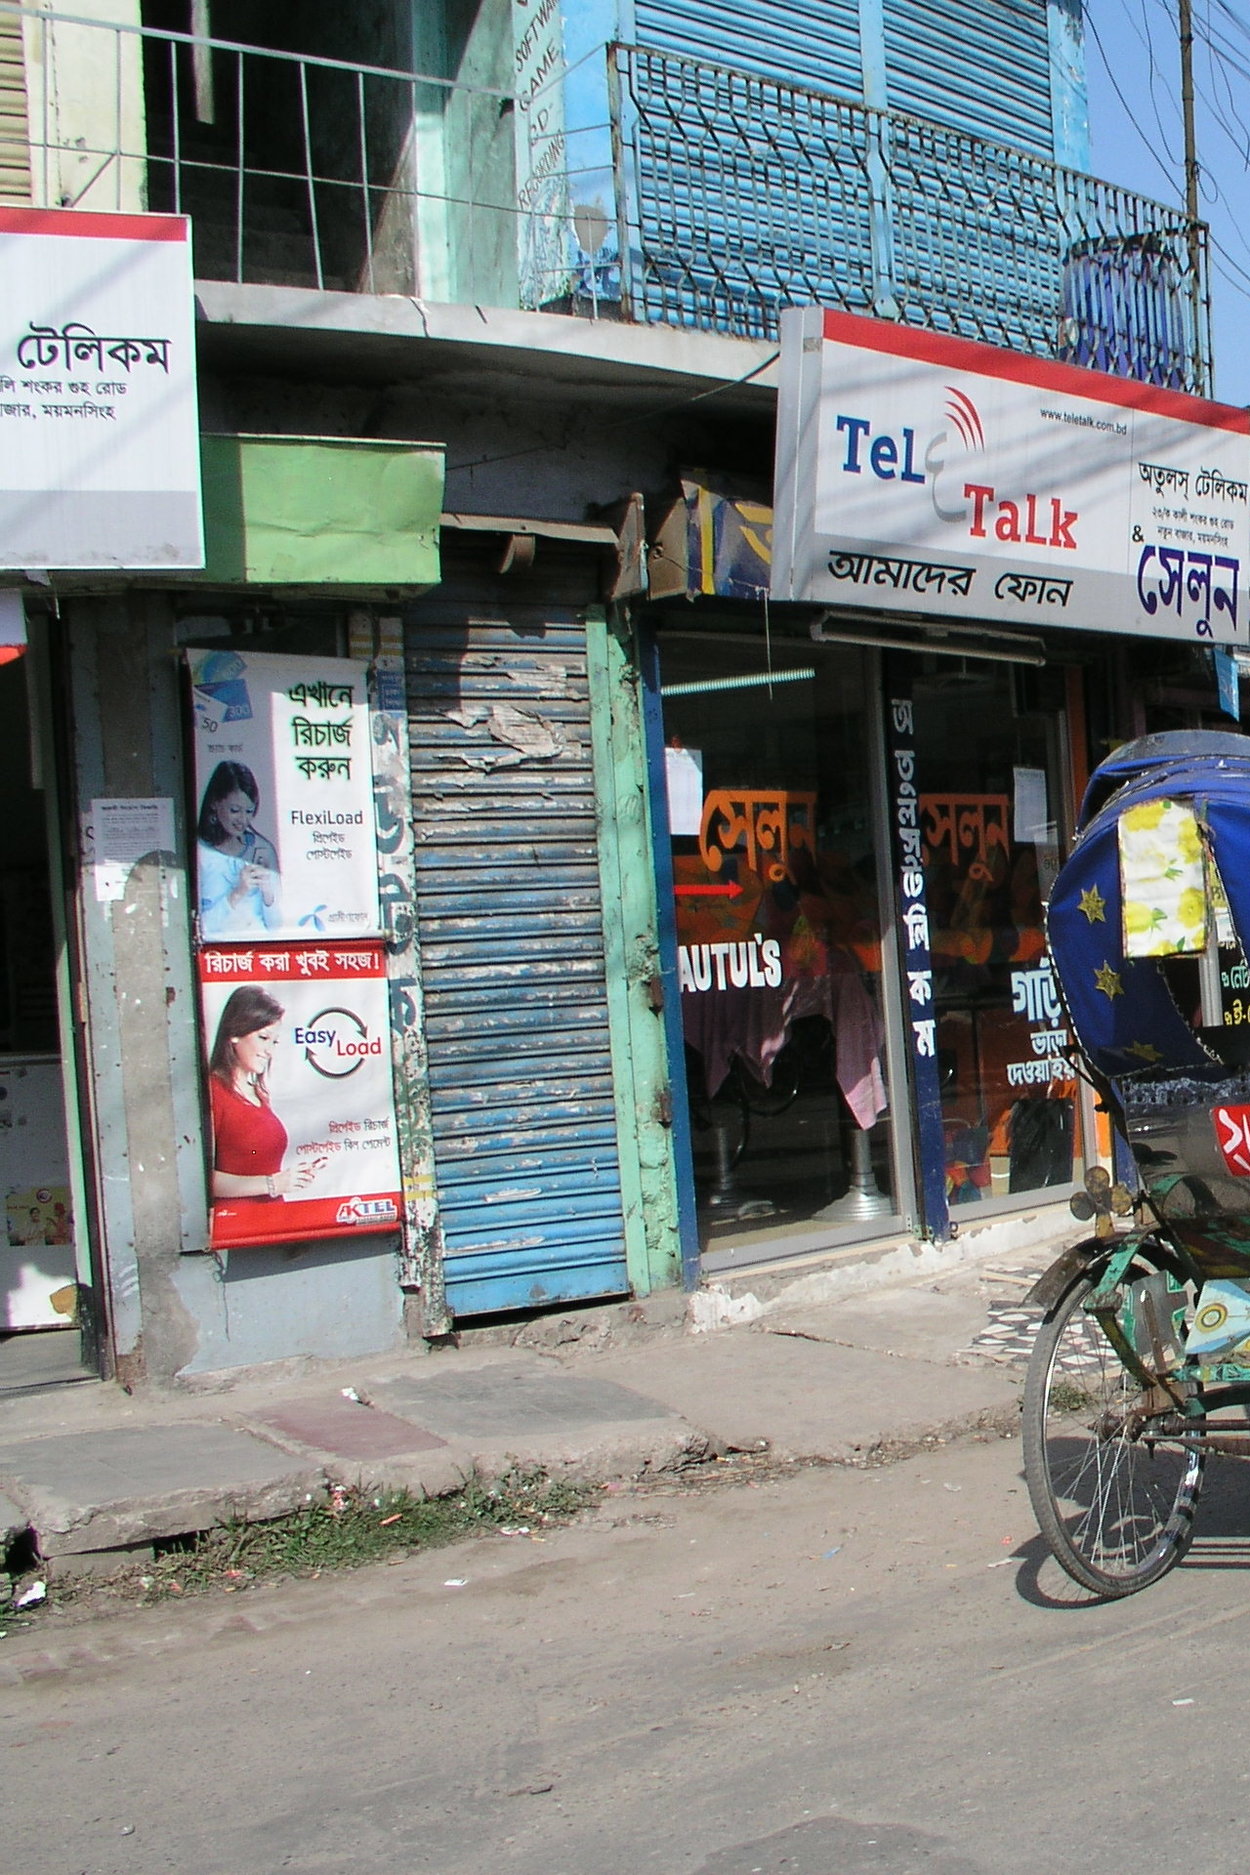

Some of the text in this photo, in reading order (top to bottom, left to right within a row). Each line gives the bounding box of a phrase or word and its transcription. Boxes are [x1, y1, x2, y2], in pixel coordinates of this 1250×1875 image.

[17, 321, 172, 374] টেলিকম
[42, 400, 118, 420] ময়মনসিংহ
[1040, 408, 1127, 435] www.teletalk.com.bd
[1195, 466, 1249, 506] টেলিকম
[1132, 525, 1144, 543] &
[827, 550, 1074, 608] আমাদের ফোন
[1137, 545, 1240, 639] সেলুন
[289, 681, 354, 709] এখানে
[202, 717, 218, 733] 50
[292, 716, 353, 748] রিচার্জ
[295, 755, 352, 782] করুন
[291, 810, 363, 825] FlexiLoad
[700, 788, 818, 885] সেলুন
[204, 950, 380, 977] রিচার্জ করা খুবই সহজ!
[678, 932, 782, 993] AUTUL'S
[294, 1026, 336, 1048] Easy
[337, 1038, 382, 1058] Load
